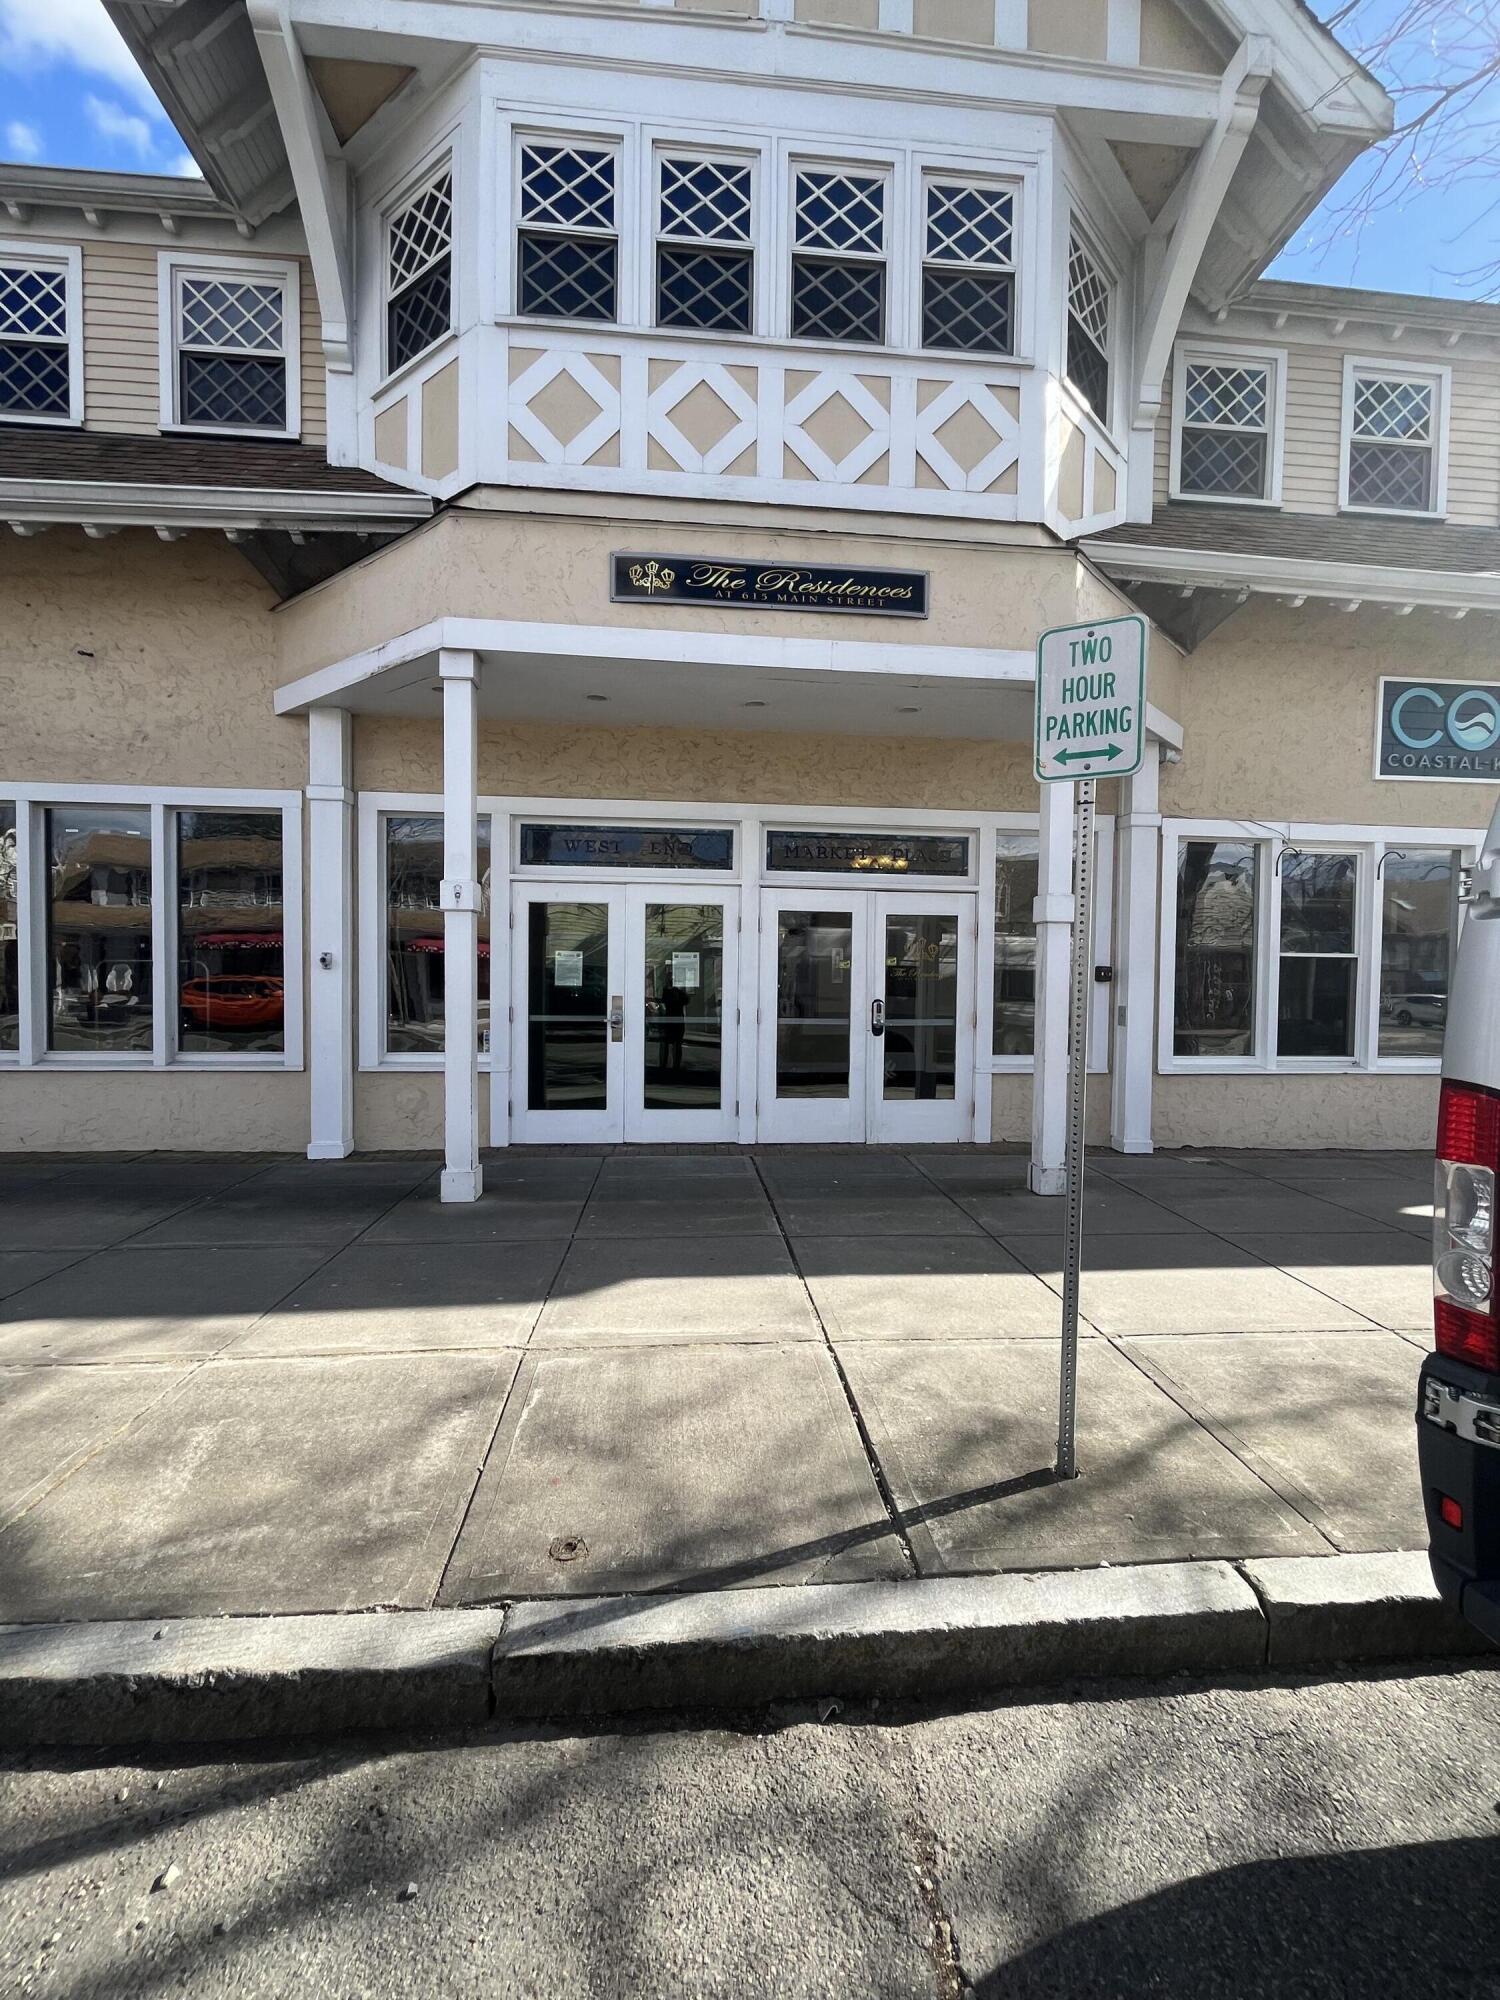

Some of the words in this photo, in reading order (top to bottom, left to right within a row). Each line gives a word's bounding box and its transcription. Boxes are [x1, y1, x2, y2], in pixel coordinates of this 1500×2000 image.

[686, 564, 747, 589] The
[755, 569, 913, 599] Residences
[715, 590, 732, 599] AT
[741, 592, 768, 601] 615
[777, 594, 818, 603] MAIN
[827, 597, 886, 607] STREET
[1069, 636, 1112, 667] TWO
[1062, 672, 1116, 704] HOUR
[1046, 706, 1132, 741] PARKING
[1388, 753, 1484, 770] COASTAL
[564, 839, 623, 854] WEST
[784, 845, 869, 860] MARKET
